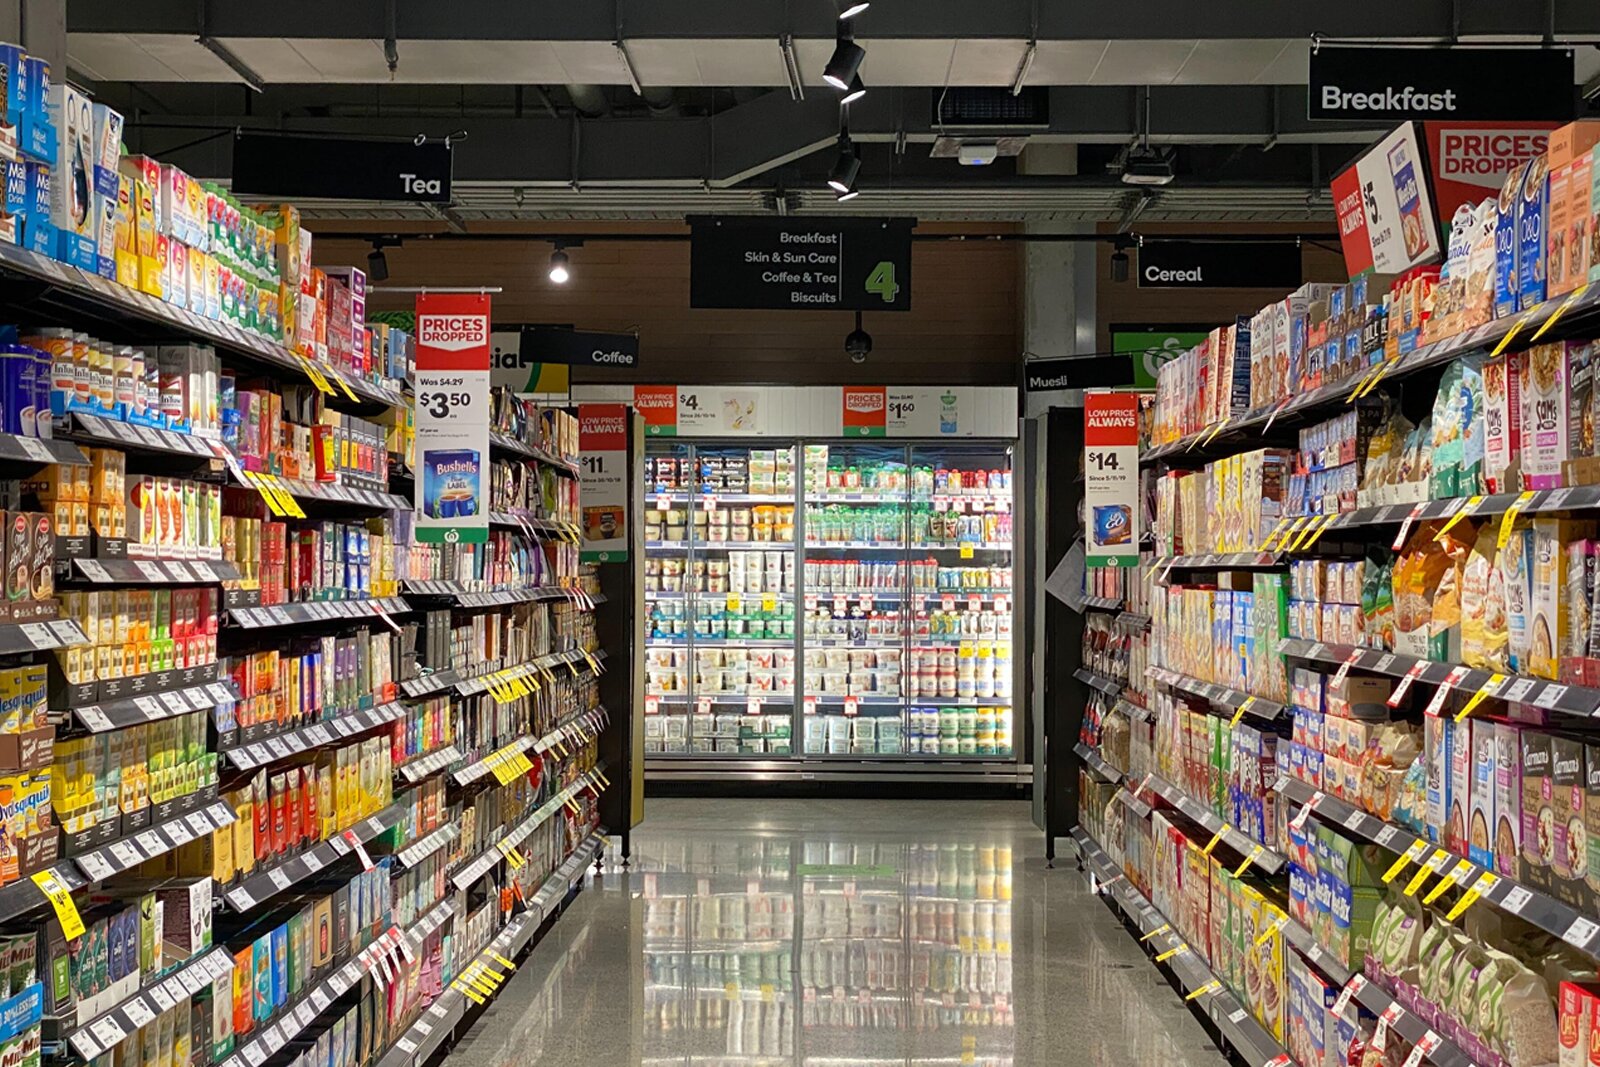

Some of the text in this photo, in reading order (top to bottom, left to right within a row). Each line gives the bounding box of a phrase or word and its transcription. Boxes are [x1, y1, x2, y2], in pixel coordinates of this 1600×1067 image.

[1322, 86, 1456, 111] Breakfast
[1445, 135, 1548, 157] PRICES
[400, 173, 441, 194] Tea
[780, 232, 838, 244] Breakfast
[744, 251, 838, 264] Skin & Sun Care
[761, 271, 837, 283] Coffee & Tea
[1145, 265, 1203, 282] Cereal
[865, 261, 899, 302] 4
[791, 292, 837, 303] Biscuits
[423, 318, 483, 332] PRICES
[423, 332, 484, 342] DROPPED
[592, 350, 634, 364] Coffee
[420, 378, 439, 386] Was
[1029, 374, 1068, 388] Muesli
[637, 400, 675, 408] ALWAYS
[680, 394, 699, 410] $4
[848, 394, 882, 403] PRICES
[1088, 409, 1135, 418] LOW PRICE
[581, 417, 624, 425] LOW PRICE
[1087, 417, 1136, 428] ALWAYS
[581, 424, 625, 434] ALWAYS
[436, 460, 477, 476] Bushells
[582, 456, 604, 474] $11
[1089, 452, 1119, 471] $14
[447, 481, 467, 490] LABEL
